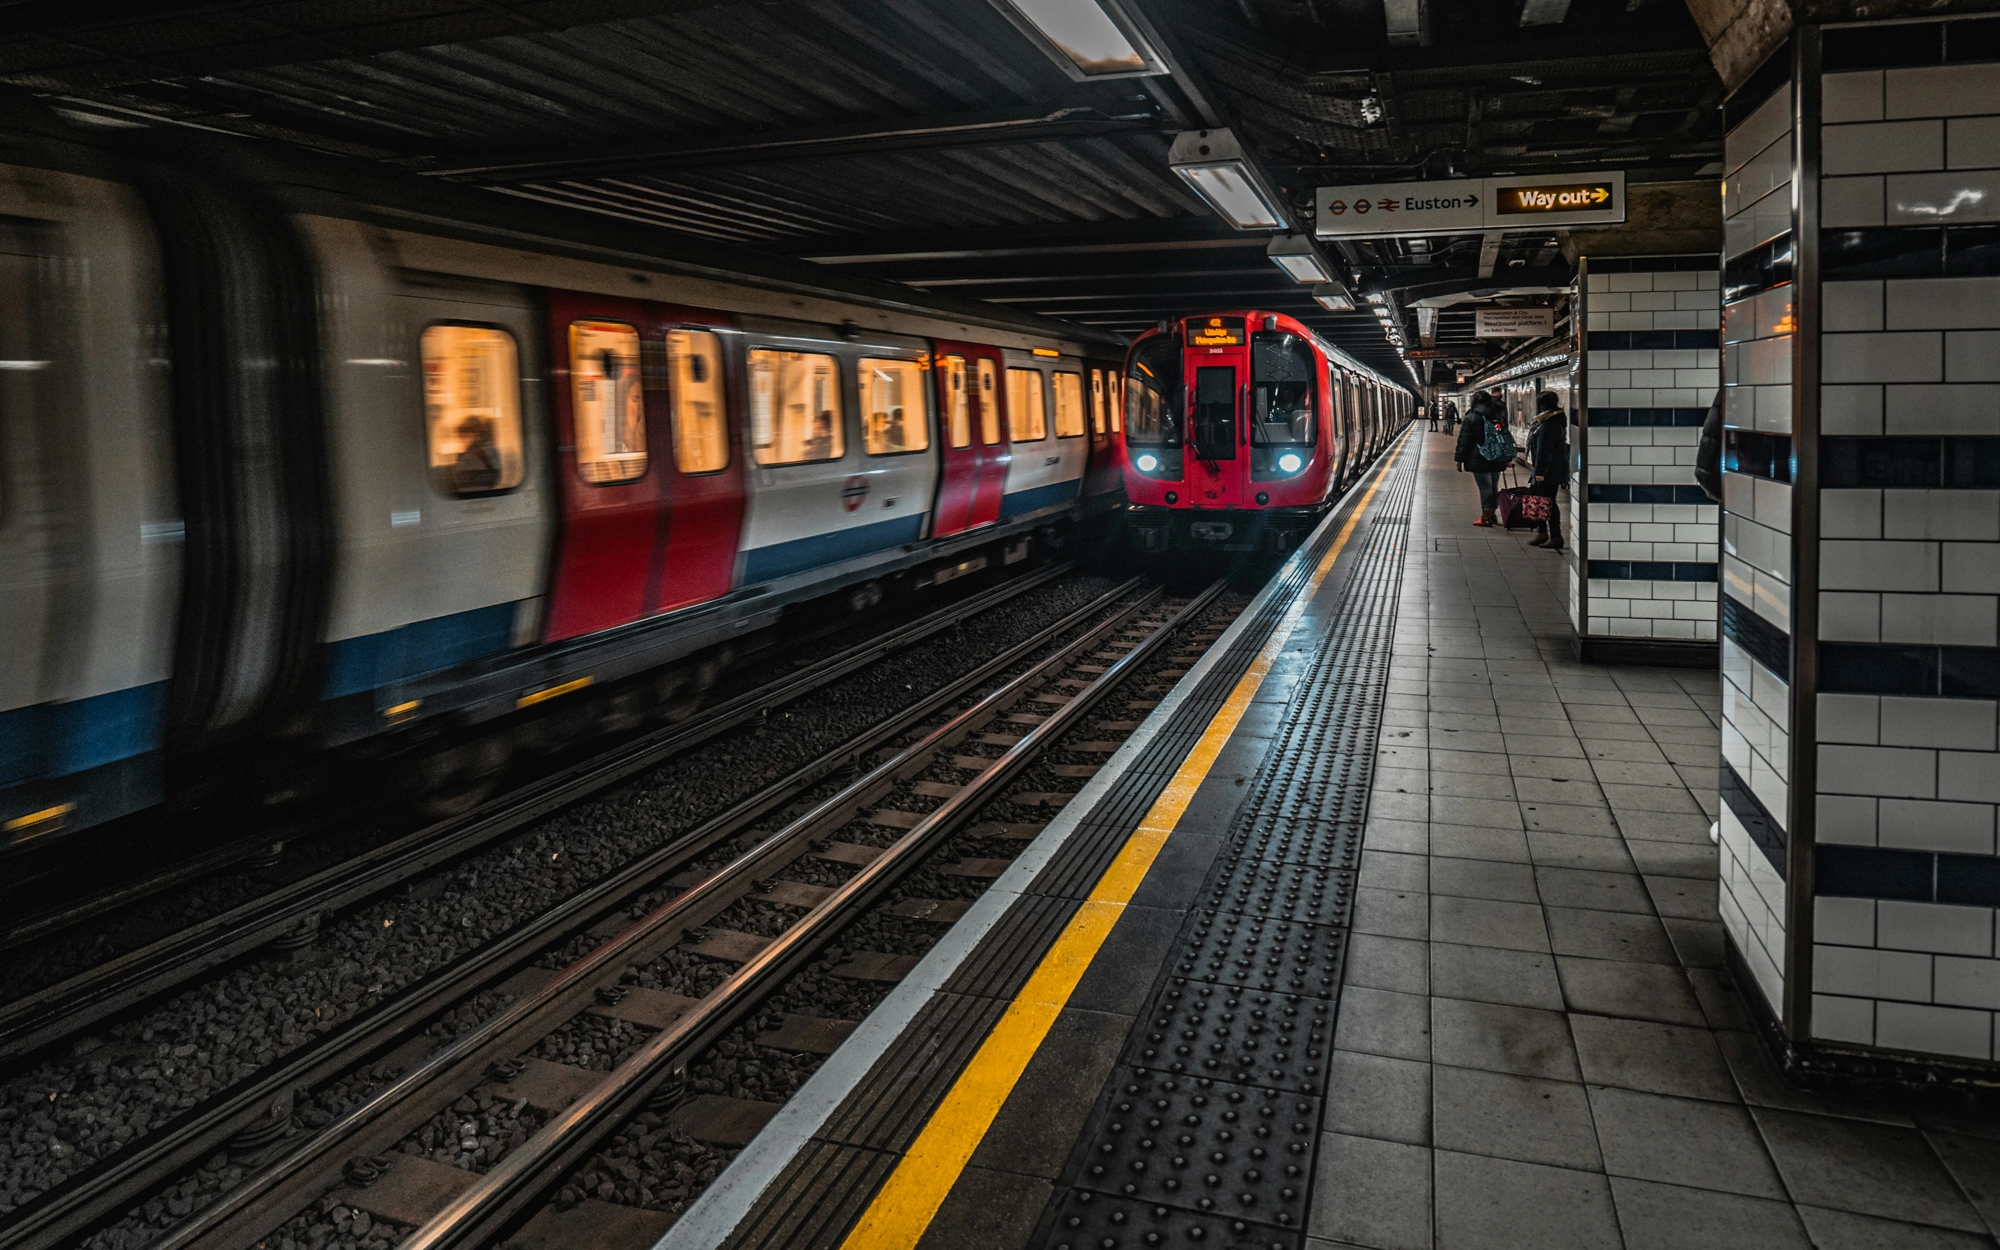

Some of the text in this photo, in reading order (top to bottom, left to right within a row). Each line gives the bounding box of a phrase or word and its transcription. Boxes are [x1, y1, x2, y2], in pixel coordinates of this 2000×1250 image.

[1405, 198, 1461, 210] Euston
[1518, 189, 1590, 208] Way out
